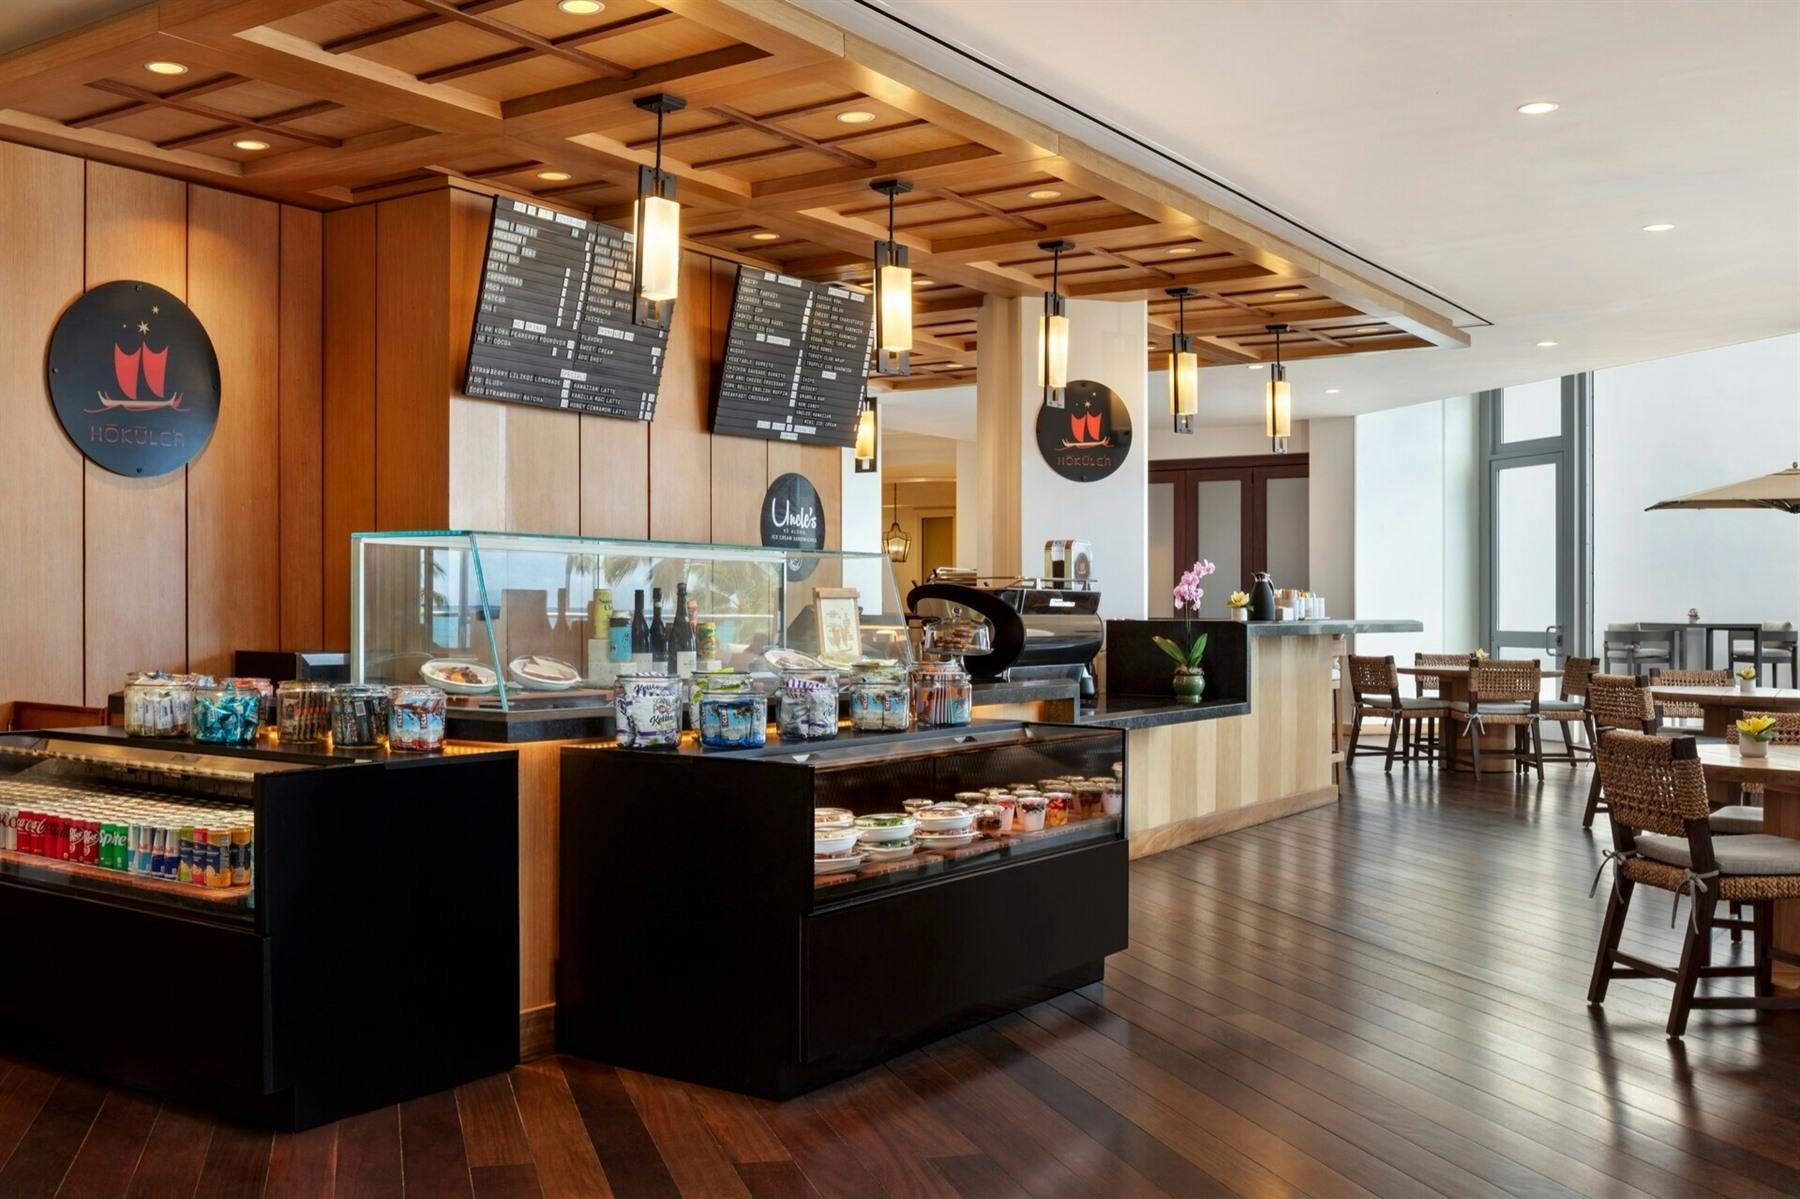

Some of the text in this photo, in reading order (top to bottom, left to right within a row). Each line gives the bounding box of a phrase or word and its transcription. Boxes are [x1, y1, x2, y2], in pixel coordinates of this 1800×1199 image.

[493, 337, 512, 347] COCOA
[471, 365, 509, 378] STRAWBERRY
[573, 382, 616, 395] HAWAIIAN LATTE
[485, 388, 520, 400] STRAWBERRY
[523, 394, 544, 404] MATCHA
[571, 392, 593, 401] VANILLA
[606, 398, 621, 406] LATTE
[570, 401, 627, 416] HONEY CINNAMON LATTE
[771, 497, 817, 529] Uncle's
